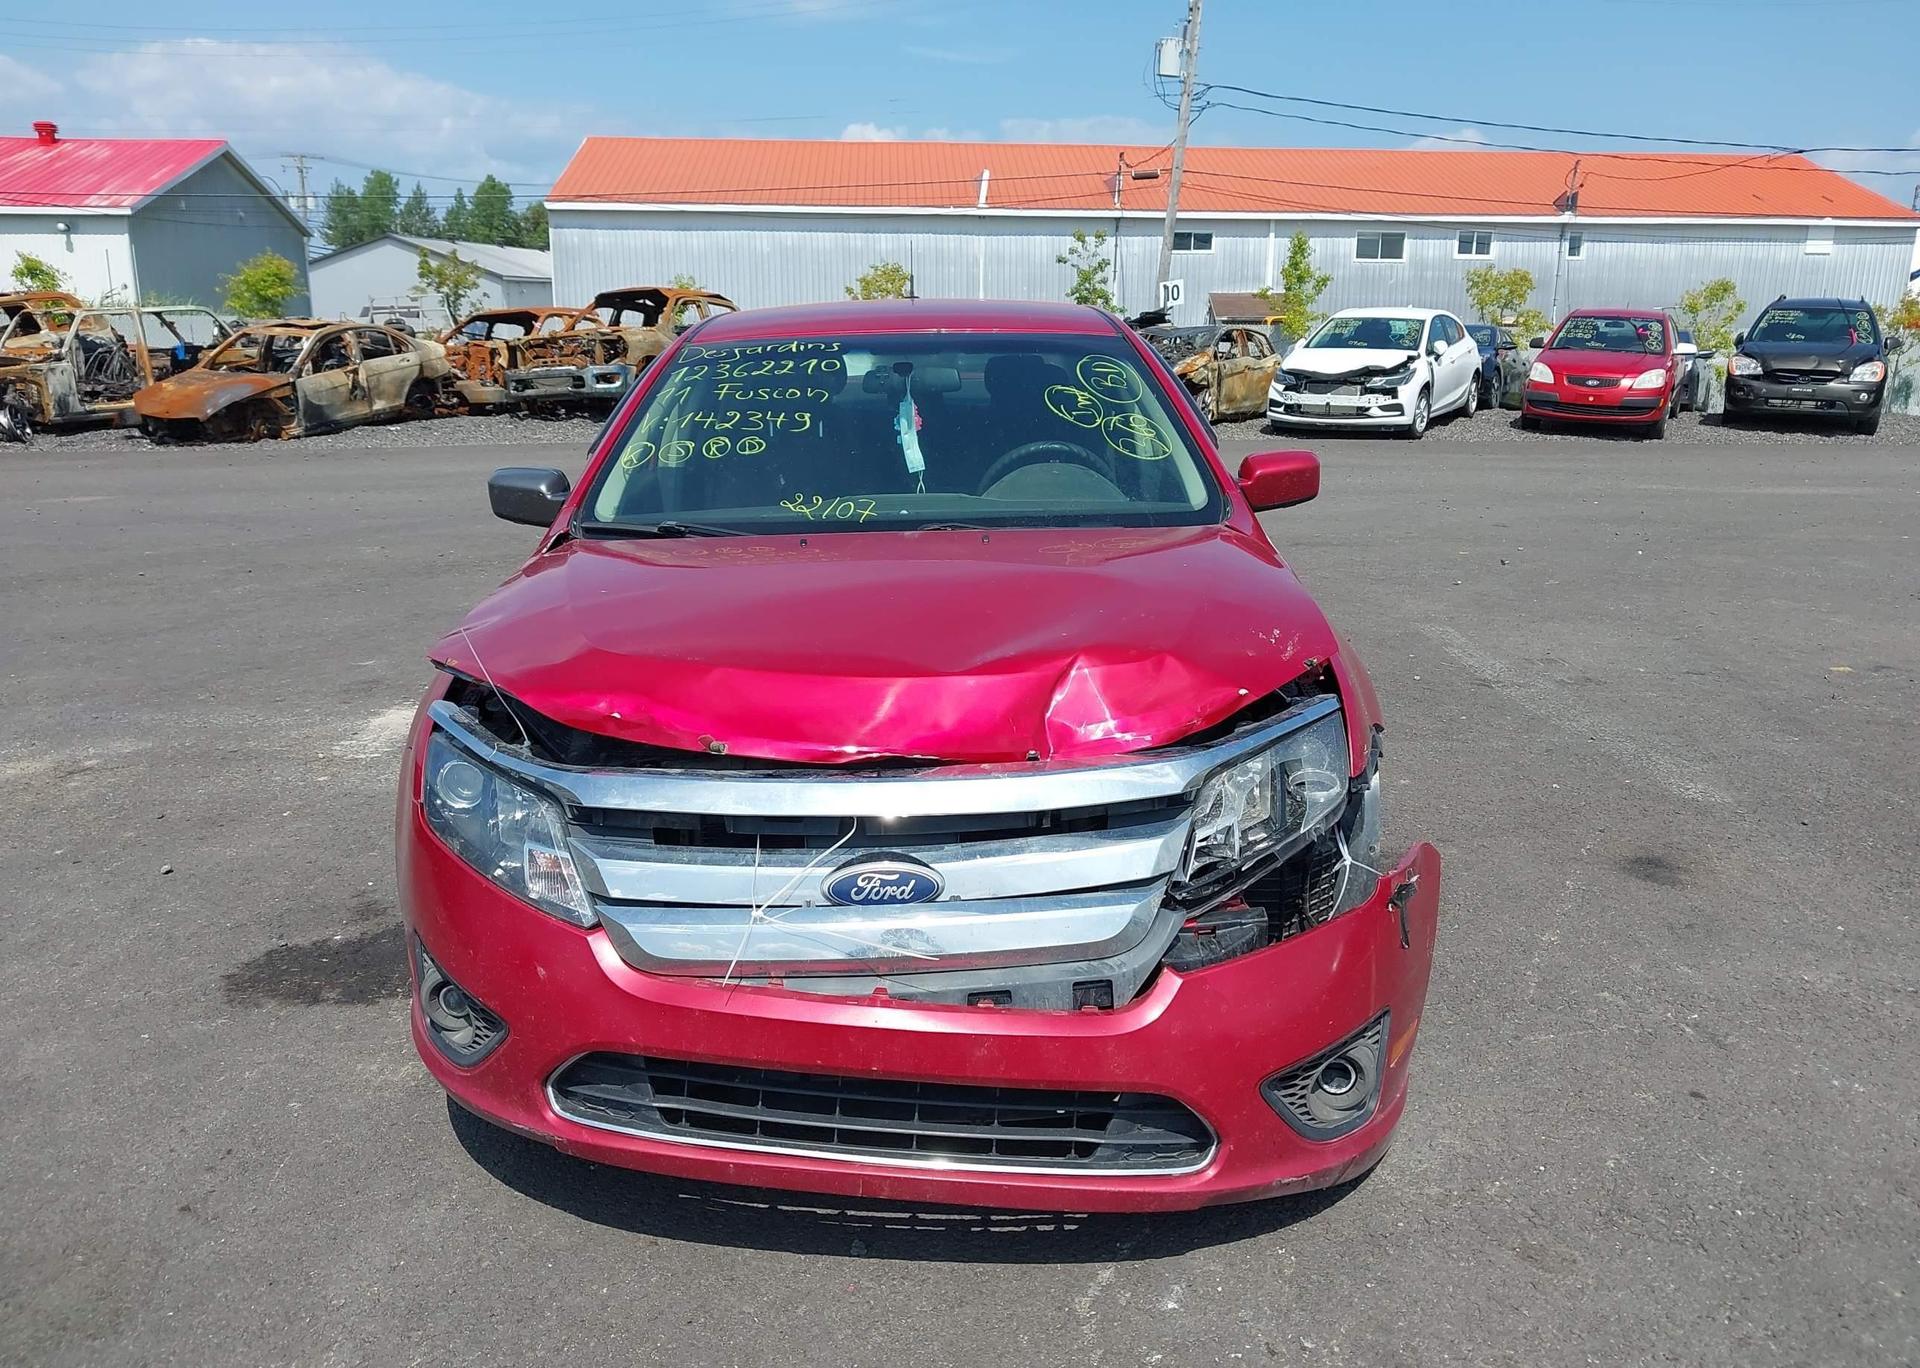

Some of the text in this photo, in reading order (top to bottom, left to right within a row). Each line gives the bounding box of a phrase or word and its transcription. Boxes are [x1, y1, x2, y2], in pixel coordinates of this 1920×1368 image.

[1164, 284, 1180, 302] 10
[672, 359, 841, 383] 12362210
[780, 493, 878, 523] 22/07
[851, 873, 917, 902] Ford
